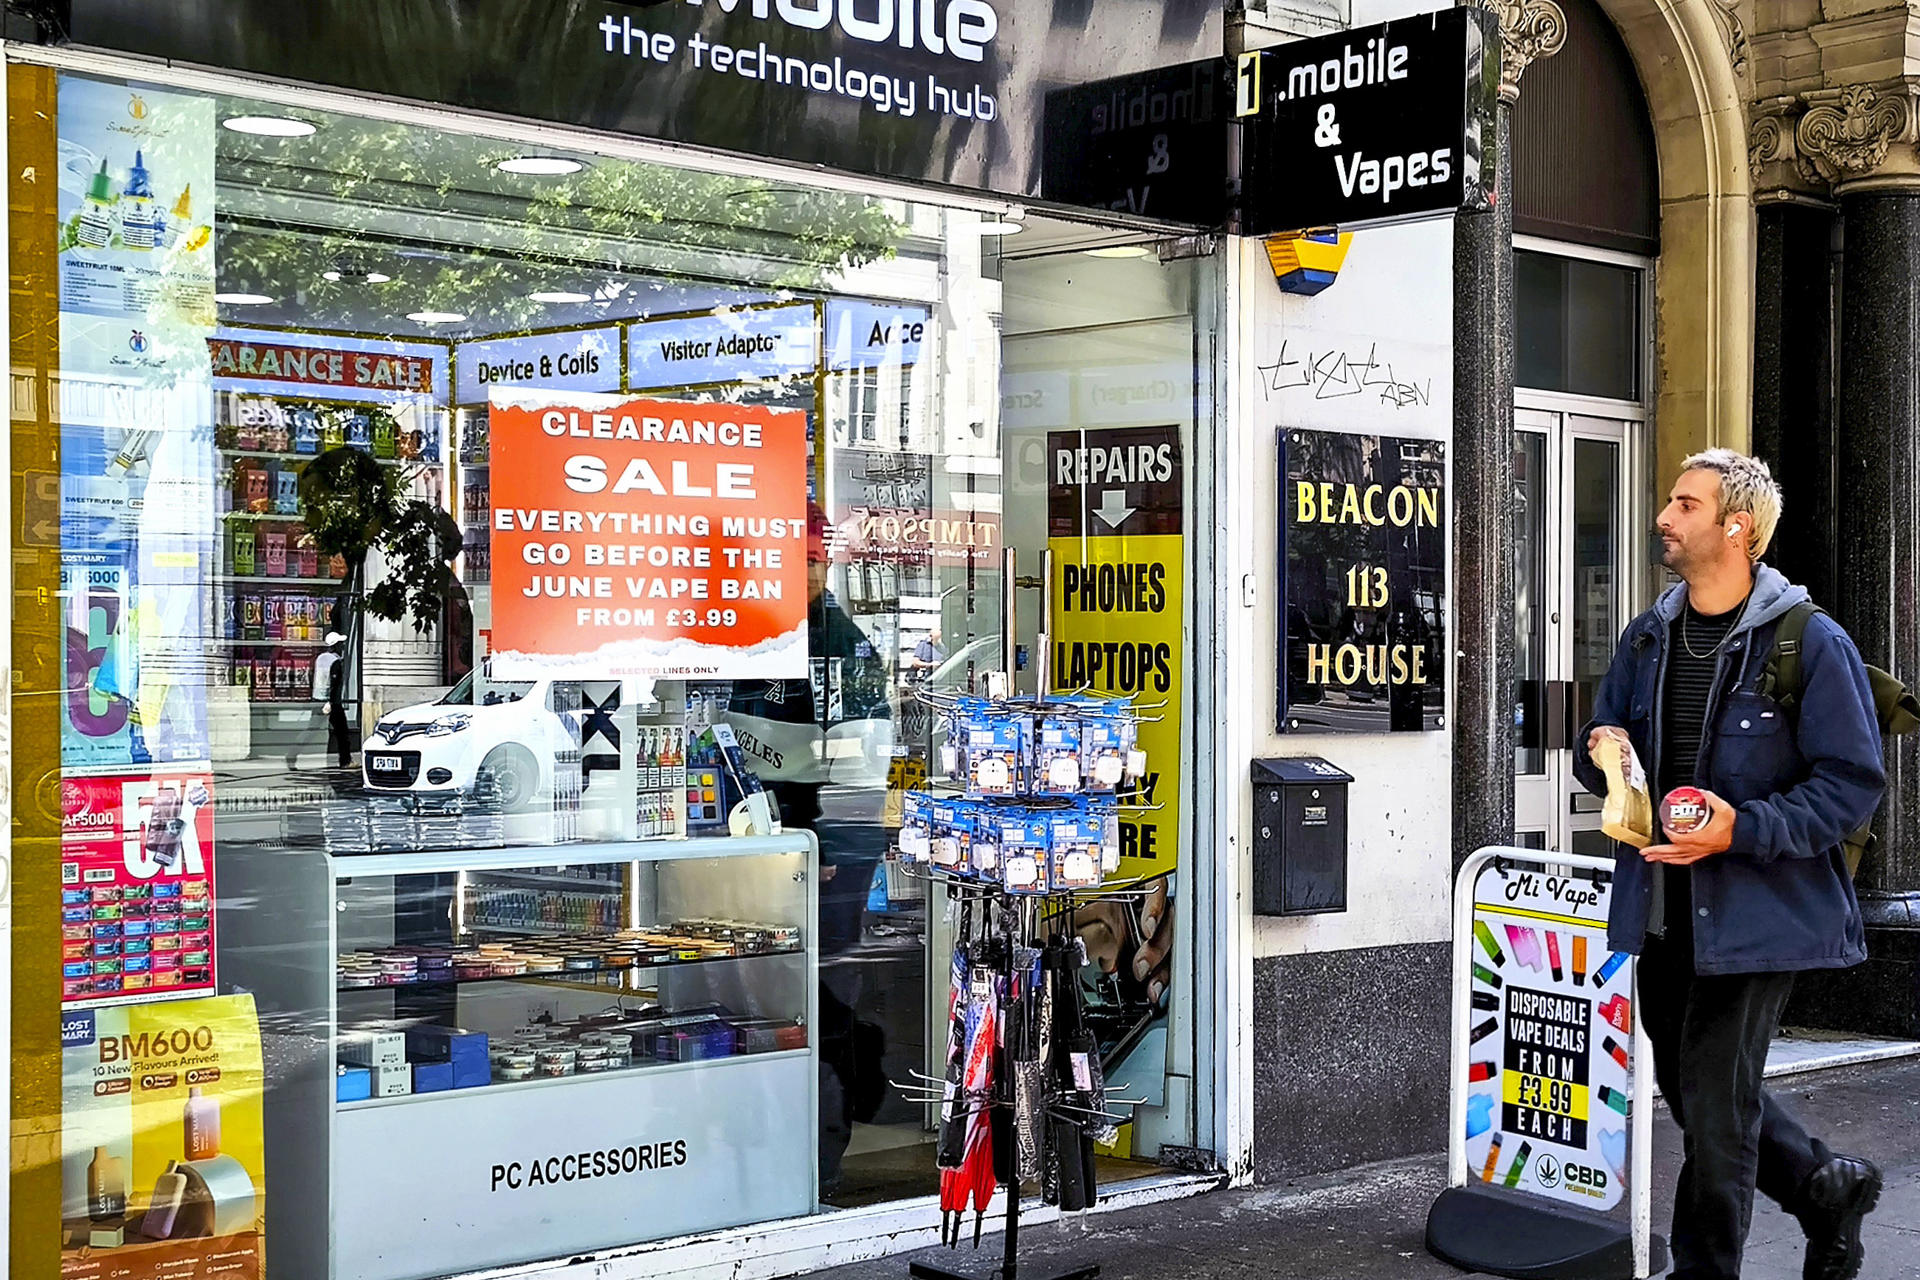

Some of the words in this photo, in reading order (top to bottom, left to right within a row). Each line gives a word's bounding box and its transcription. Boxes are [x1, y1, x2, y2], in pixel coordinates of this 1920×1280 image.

[687, 0, 998, 62] ile
[599, 15, 676, 62] the
[688, 31, 916, 117] technology
[928, 74, 998, 121] hub
[1314, 103, 1342, 148] &
[1335, 148, 1451, 203] Vapes
[65, 260, 108, 271] SWEETFRUIT
[211, 344, 343, 382] ARANCE
[354, 356, 421, 388] SALE
[478, 358, 534, 385] Device
[540, 355, 552, 378] &
[557, 350, 599, 377] Coils
[661, 338, 712, 362] Visitor
[540, 411, 763, 448] CLEARANCE
[564, 454, 757, 500] SALE
[1055, 443, 1174, 486] REPAIRS
[494, 508, 710, 537] EVERYTHING
[722, 516, 806, 539] MUST
[1296, 481, 1439, 529] BEACON
[522, 542, 571, 565] GO
[584, 543, 711, 567] BEFORE
[722, 548, 782, 568] THE
[522, 575, 613, 598] JUNE
[625, 577, 709, 599] VAPE
[721, 578, 782, 599] BAN
[1063, 562, 1166, 614] PHONES
[1346, 563, 1389, 608] 113
[577, 607, 655, 627] FROM
[665, 608, 737, 627] £3.99
[609, 667, 660, 675] SELECTED
[693, 666, 719, 674] ONLY
[1058, 640, 1171, 694] LAPTOPS
[1307, 643, 1428, 687] HOUSE
[1118, 822, 1157, 860] RE
[1505, 873, 1540, 901] Mi
[1546, 877, 1598, 914] Vape
[61, 1019, 90, 1031] LOST
[1510, 990, 1587, 1026] DISPOSABLE
[61, 1029, 90, 1040] MARY
[99, 1025, 213, 1063] BM600
[1510, 1018, 1542, 1045] VAPE
[1545, 1024, 1585, 1053] DEALS
[92, 1066, 105, 1077] 10
[107, 1064, 131, 1075] New
[134, 1057, 178, 1072] Flavours
[180, 1053, 220, 1067] Arrived!
[1519, 1048, 1574, 1082] FROM
[1517, 1074, 1572, 1115] £3.99
[1517, 1107, 1572, 1142] EACH
[490, 1160, 522, 1192] PC
[528, 1139, 687, 1187] ACCESSORIES
[1564, 1162, 1607, 1189] CBD
